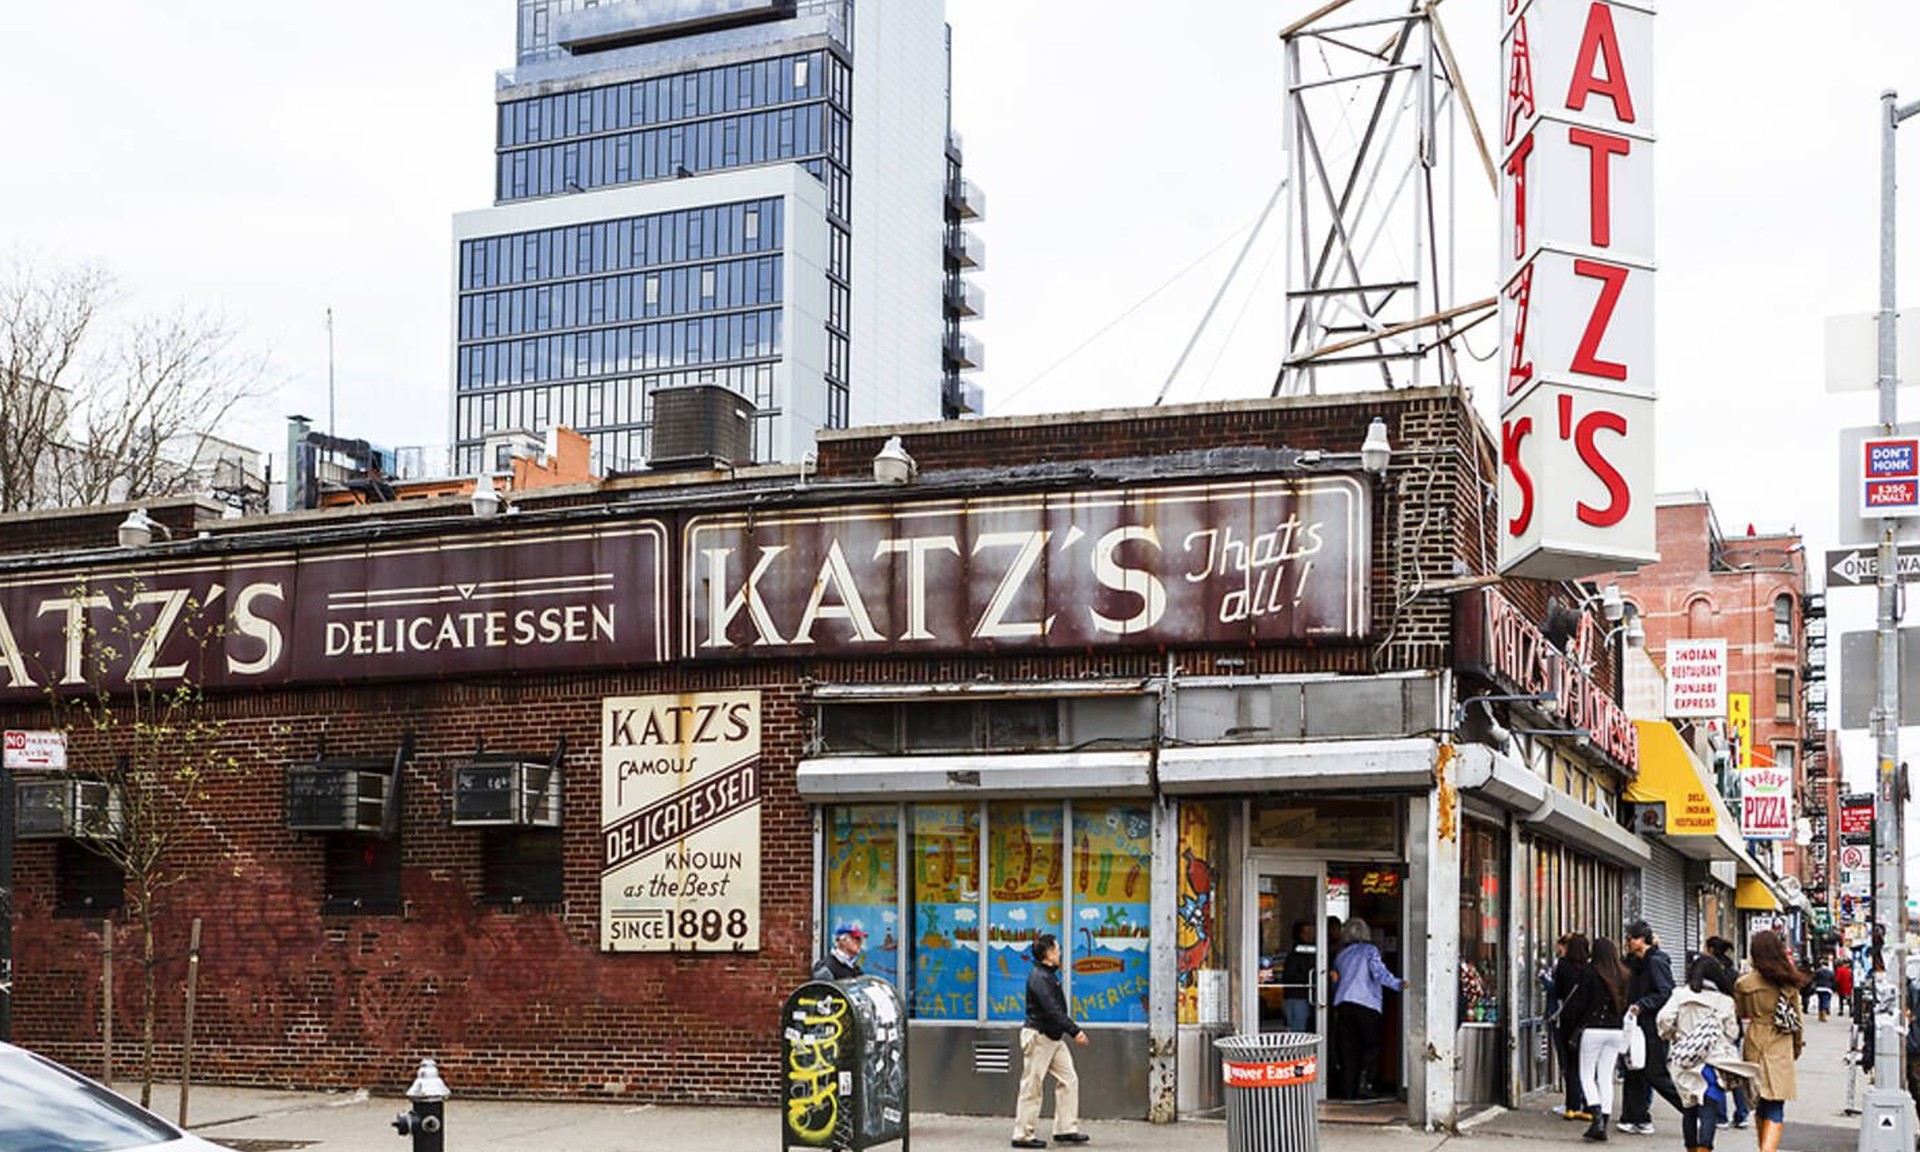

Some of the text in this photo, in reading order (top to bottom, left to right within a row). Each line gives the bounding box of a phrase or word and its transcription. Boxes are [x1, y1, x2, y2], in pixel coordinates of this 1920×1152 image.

[1872, 447, 1911, 460] DON'T
[1873, 459, 1911, 471] HONK
[1871, 492, 1912, 504] PENALTY
[1844, 556, 1920, 576] ONE WA
[701, 523, 1168, 648] KATZ'S
[324, 603, 617, 657] DELICATESSEN
[1675, 649, 1717, 661] INDIAN
[1671, 665, 1722, 678] RESTAURANT
[1674, 683, 1717, 693] PUNJABI
[1674, 698, 1717, 709] EXPRESS
[609, 702, 751, 747] KATZ'S
[7, 735, 25, 748] NO
[606, 767, 754, 864] DELICATESSEN
[1744, 796, 1789, 829] PIZZA
[664, 851, 742, 870] KNOWN
[623, 873, 730, 898] as the Best
[610, 920, 664, 940] SINCE
[1071, 974, 1149, 1021] AMERICA
